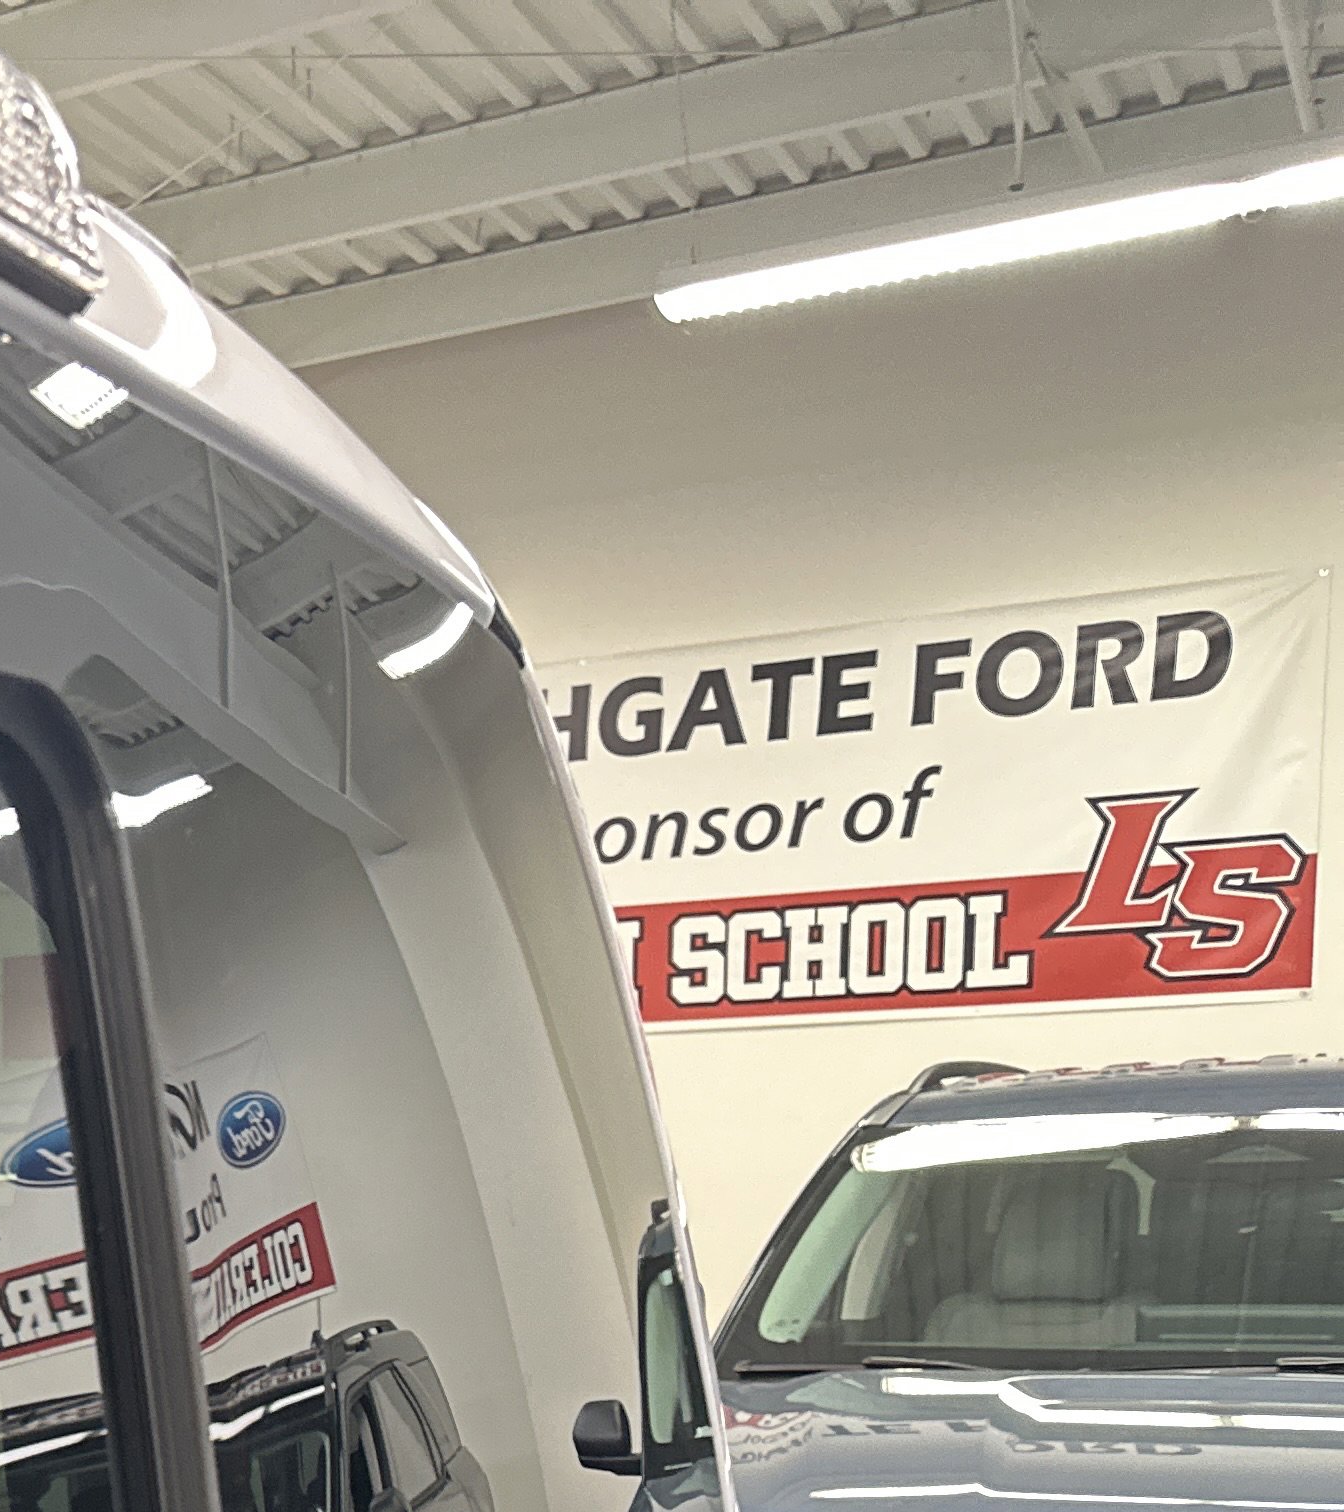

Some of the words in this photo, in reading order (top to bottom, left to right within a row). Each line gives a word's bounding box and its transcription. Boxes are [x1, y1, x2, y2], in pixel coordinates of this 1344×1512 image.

[911, 610, 1234, 728] FORD
[593, 795, 824, 864] onsor
[843, 765, 943, 845] of
[1040, 787, 1310, 982] LS
[668, 893, 1034, 1007] SCHOOL
